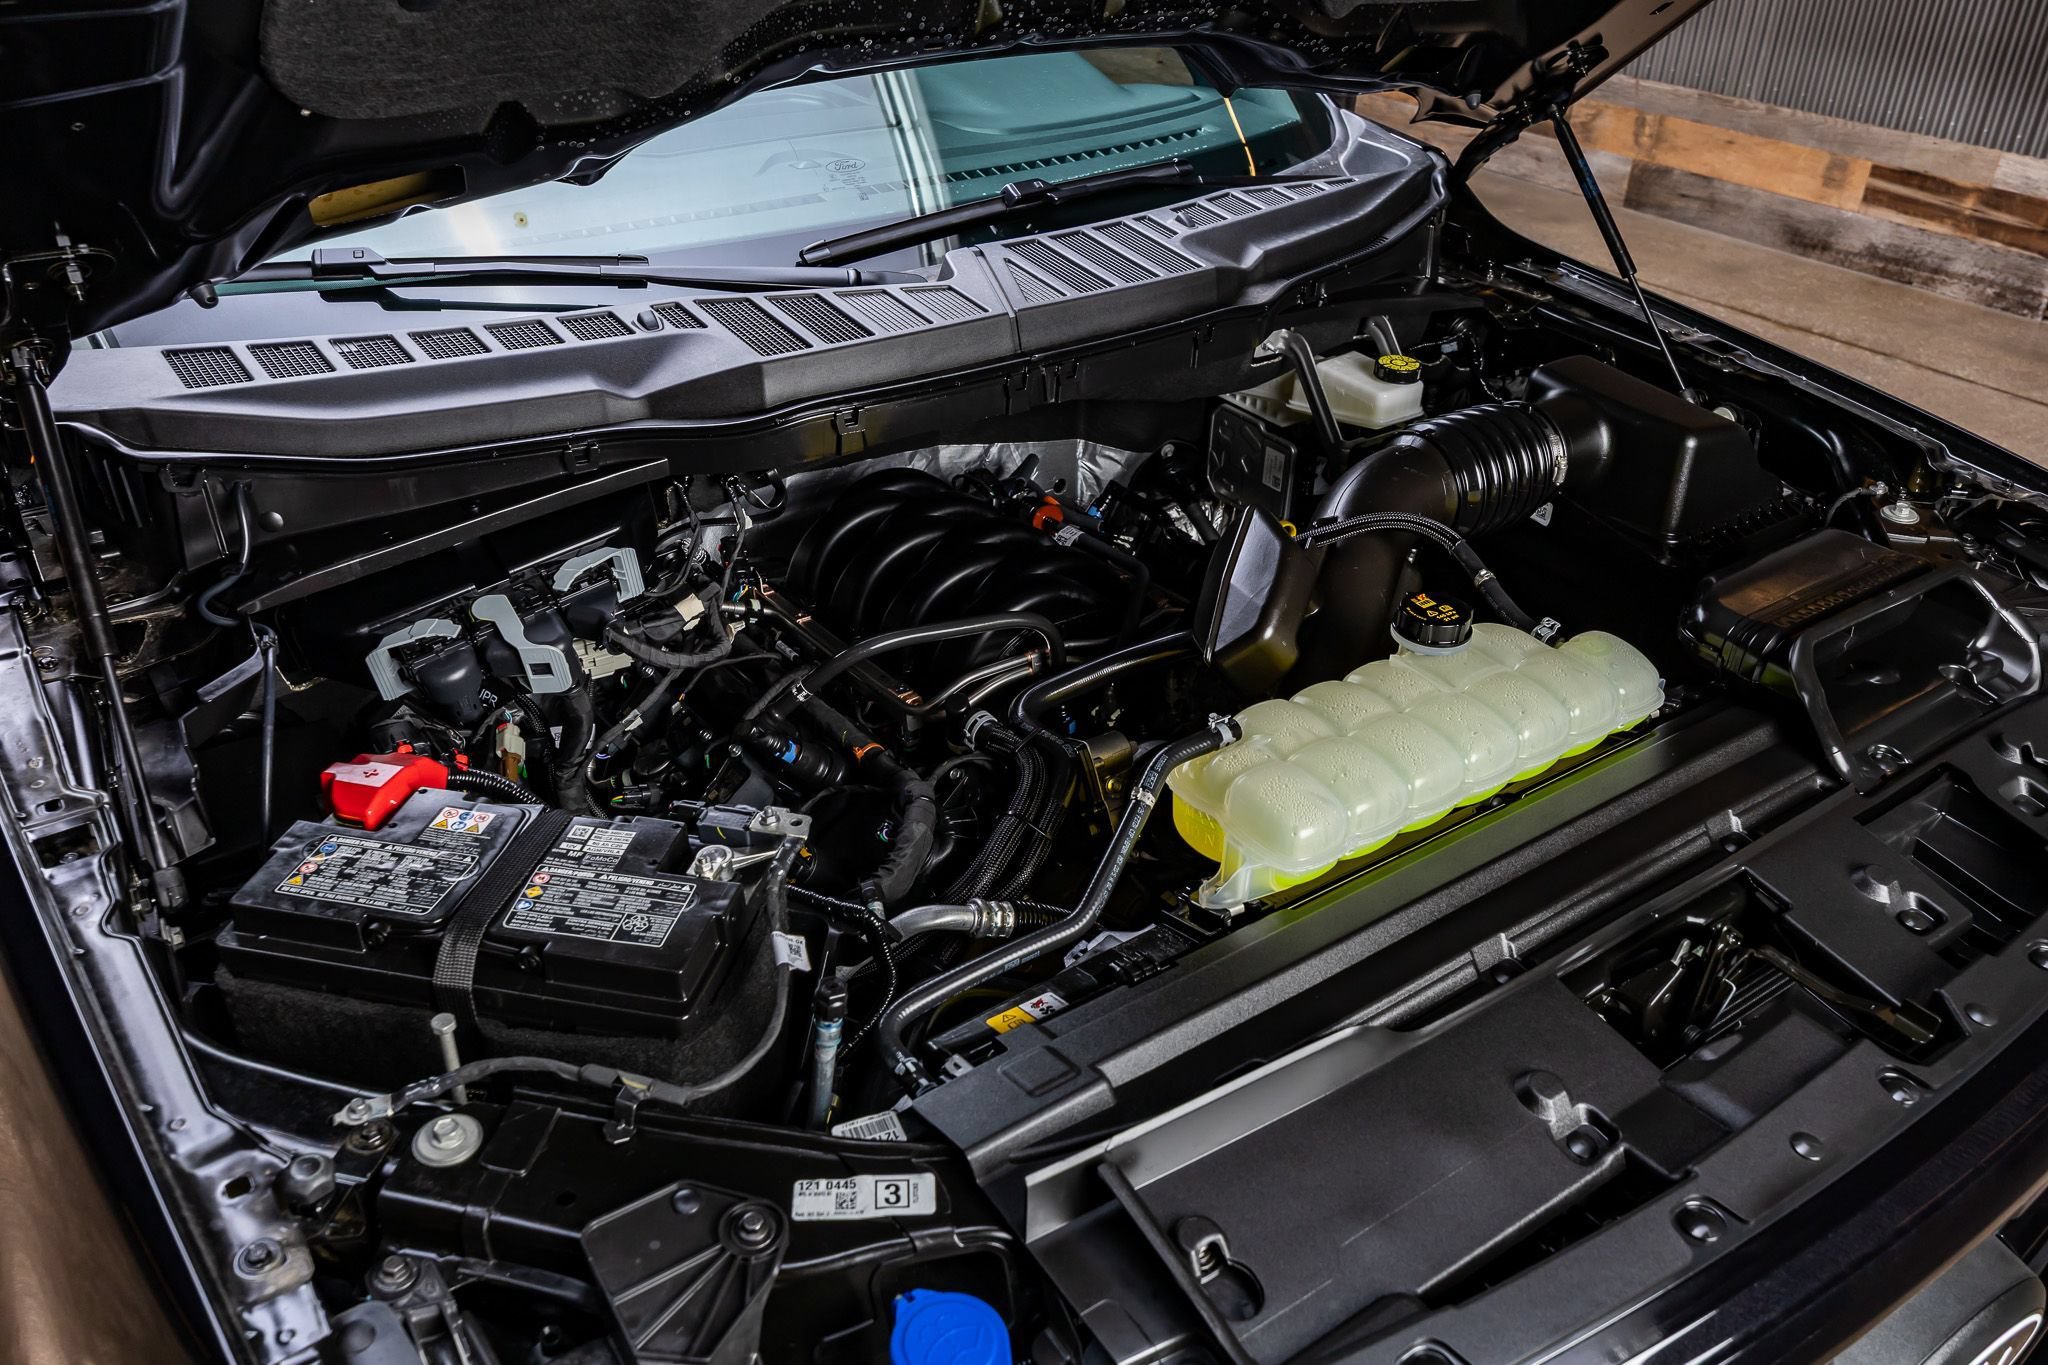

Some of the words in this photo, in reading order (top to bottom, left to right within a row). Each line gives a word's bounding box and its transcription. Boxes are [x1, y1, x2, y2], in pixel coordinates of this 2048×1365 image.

[834, 160, 858, 171] Ford
[585, 854, 618, 863] FoMoCo
[799, 1181, 820, 1191] 121
[826, 1179, 857, 1190] 0445
[884, 1183, 902, 1205] 3
